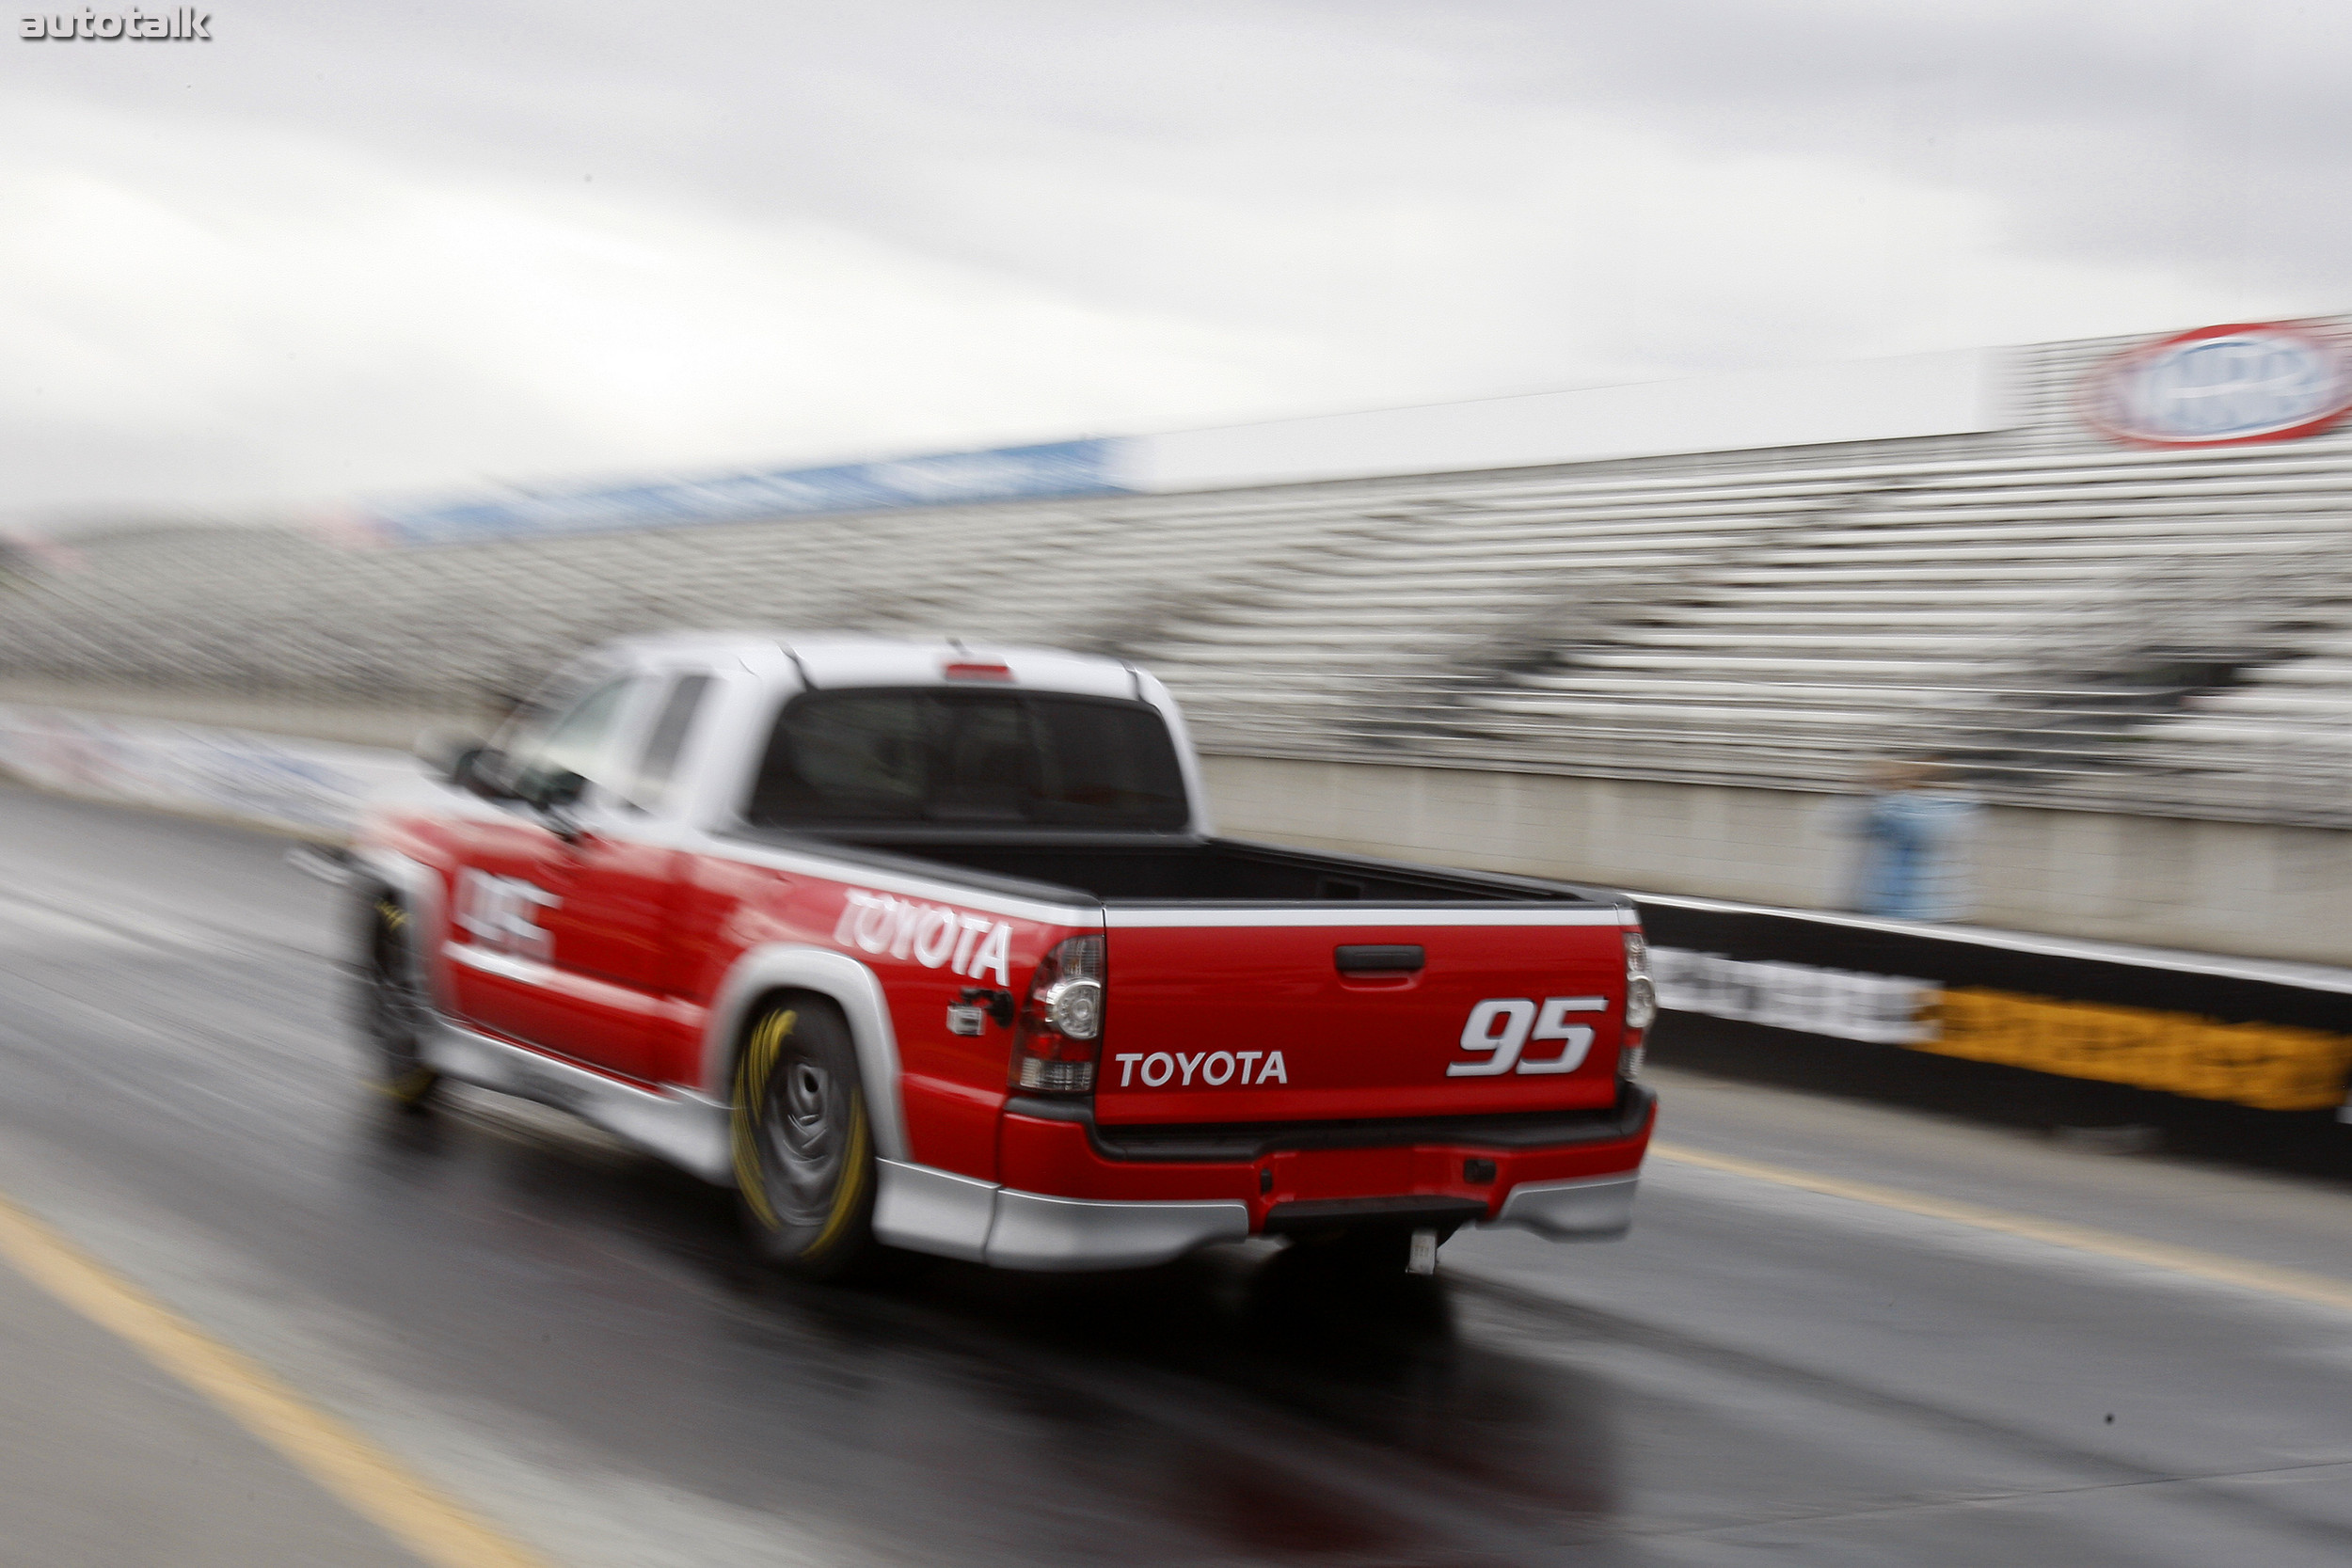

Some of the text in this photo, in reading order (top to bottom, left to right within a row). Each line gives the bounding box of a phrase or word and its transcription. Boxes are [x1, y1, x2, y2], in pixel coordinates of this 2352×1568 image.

[834, 888, 1013, 987] TOYOTA
[1115, 1051, 1288, 1086] TOYOTA
[1446, 997, 1608, 1077] 95
